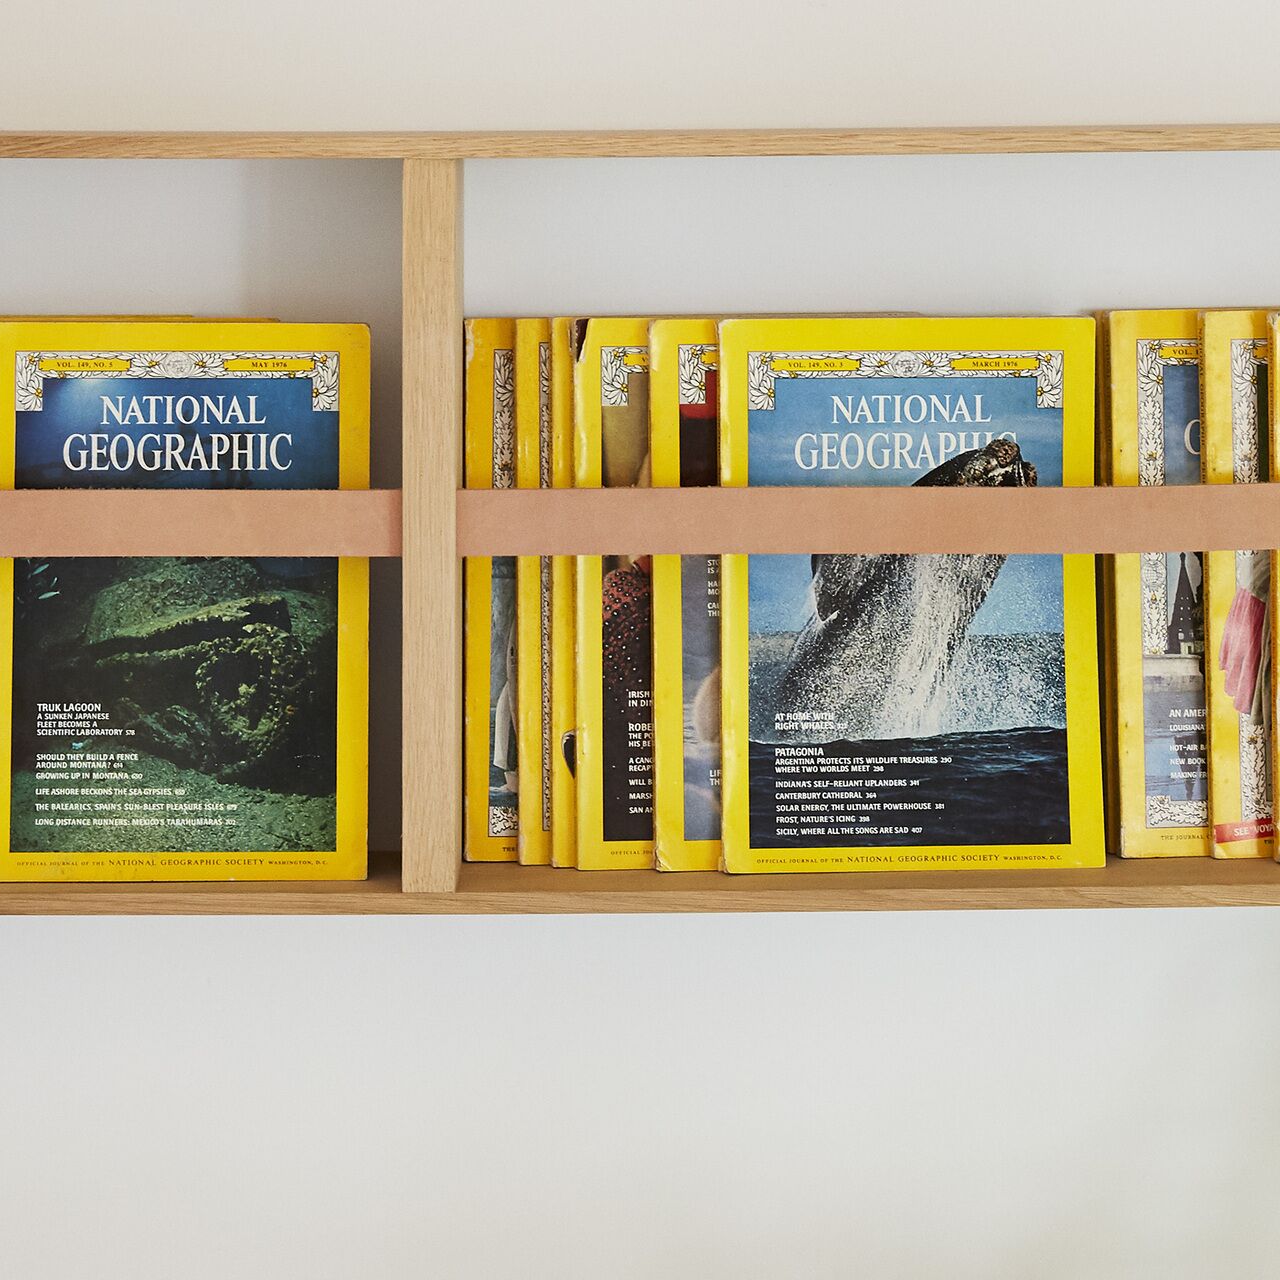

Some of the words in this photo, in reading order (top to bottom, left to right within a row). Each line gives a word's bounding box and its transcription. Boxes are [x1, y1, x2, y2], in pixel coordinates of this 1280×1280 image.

[100, 395, 266, 425] NATIONAL
[831, 394, 992, 424] NATIONAL
[63, 433, 292, 471] GEOGRAPHIC
[628, 691, 650, 699] IRISH
[37, 703, 61, 712] TRUK
[63, 703, 101, 712] LAGOON
[1169, 709, 1181, 717] AN
[775, 748, 824, 756] PATAGONIA
[1169, 744, 1199, 752] HOT-AIR
[775, 792, 821, 800] CANTERBURY
[801, 804, 829, 812] ENERGY,
[776, 816, 799, 824] FROST,
[776, 828, 799, 836] SICILY,
